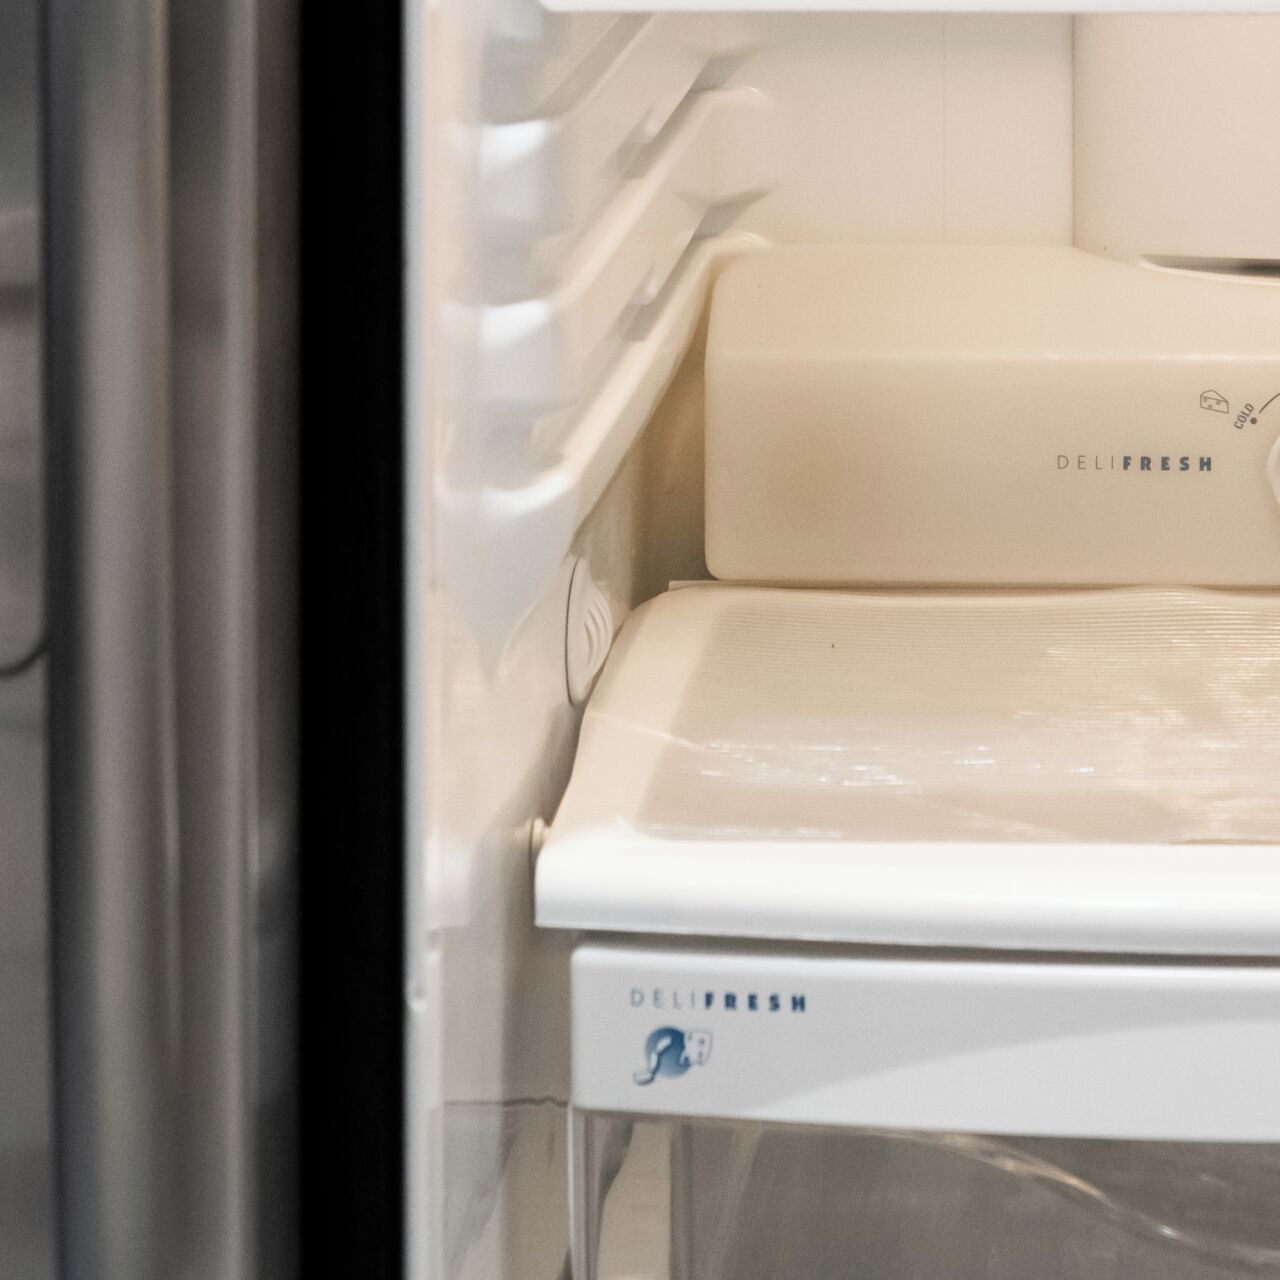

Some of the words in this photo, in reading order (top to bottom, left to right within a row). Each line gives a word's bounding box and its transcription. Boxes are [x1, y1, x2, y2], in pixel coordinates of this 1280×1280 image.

[1233, 402, 1255, 430] COLD
[1057, 455, 1213, 472] DELIFRESH
[630, 988, 807, 1013] DELIFRESH
